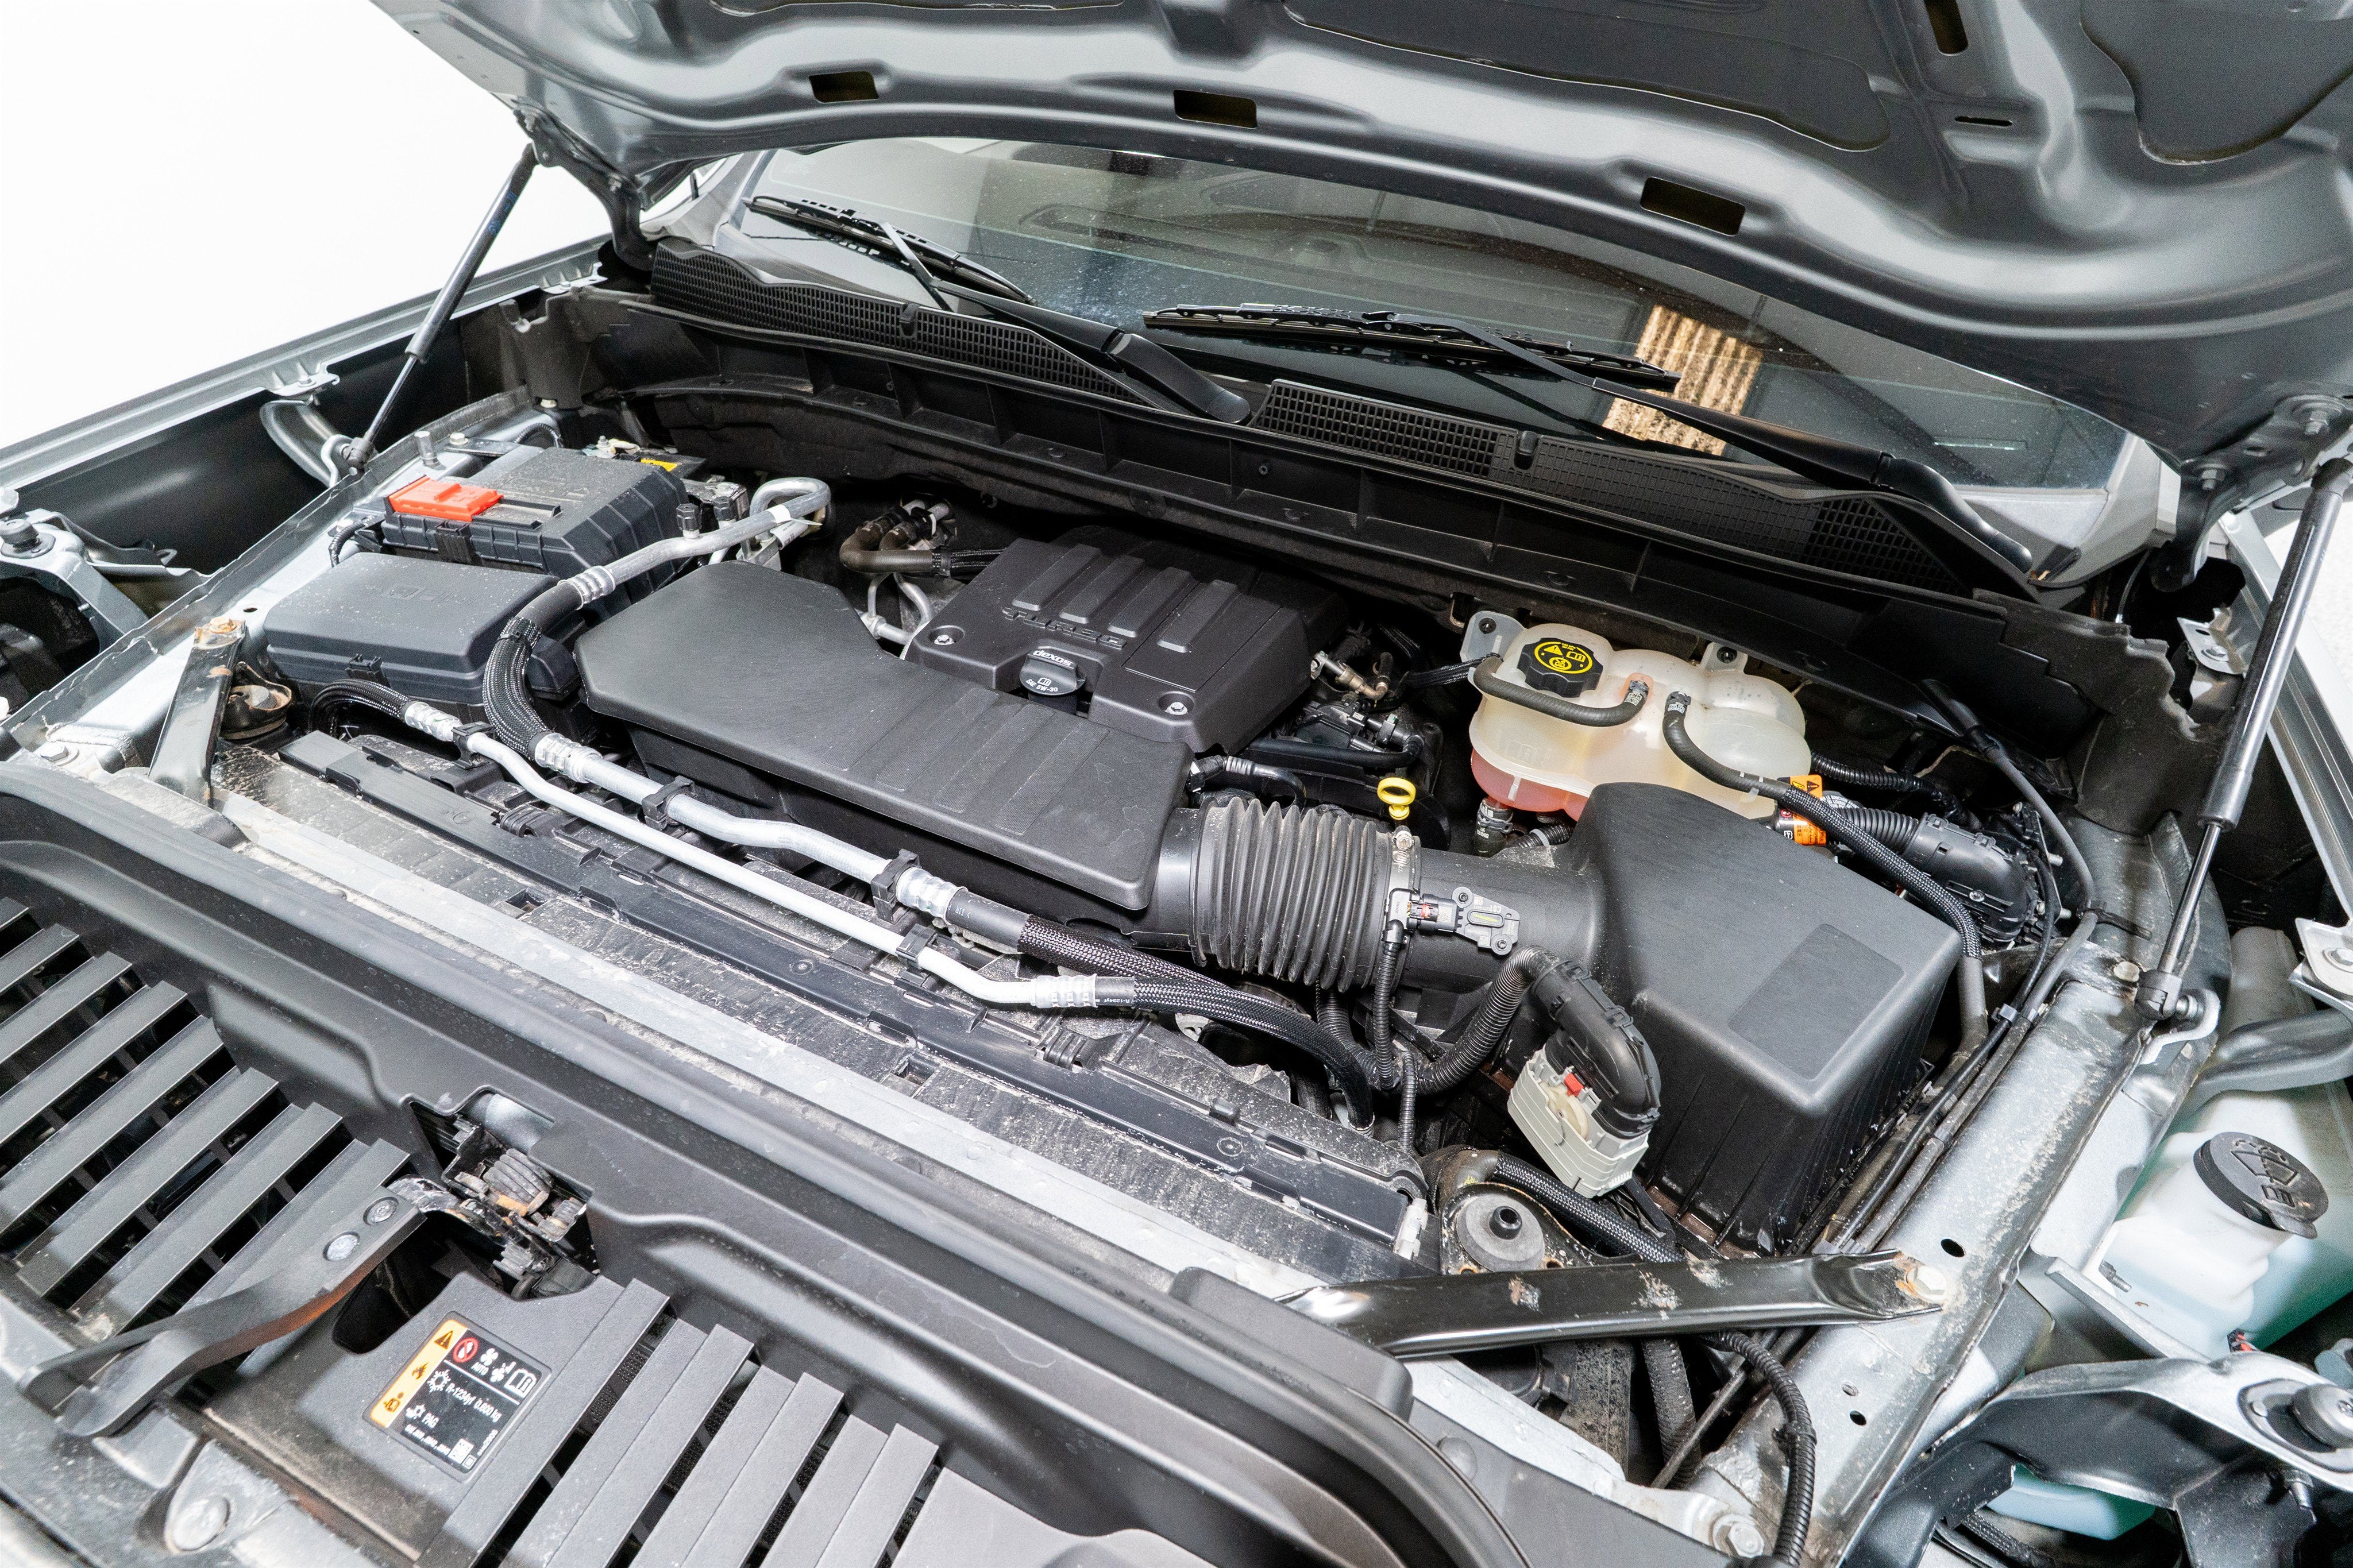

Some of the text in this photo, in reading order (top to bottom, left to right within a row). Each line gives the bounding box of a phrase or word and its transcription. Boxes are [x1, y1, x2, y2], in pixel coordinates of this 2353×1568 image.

[1002, 607, 1128, 650] TURBO
[1033, 650, 1074, 666] dexos
[1026, 679, 1058, 692] SAE 5W-30
[470, 1361, 489, 1376] AUTO
[446, 1383, 476, 1405] R-1234yf
[491, 1409, 502, 1422] kg
[422, 1413, 439, 1428] PAG
